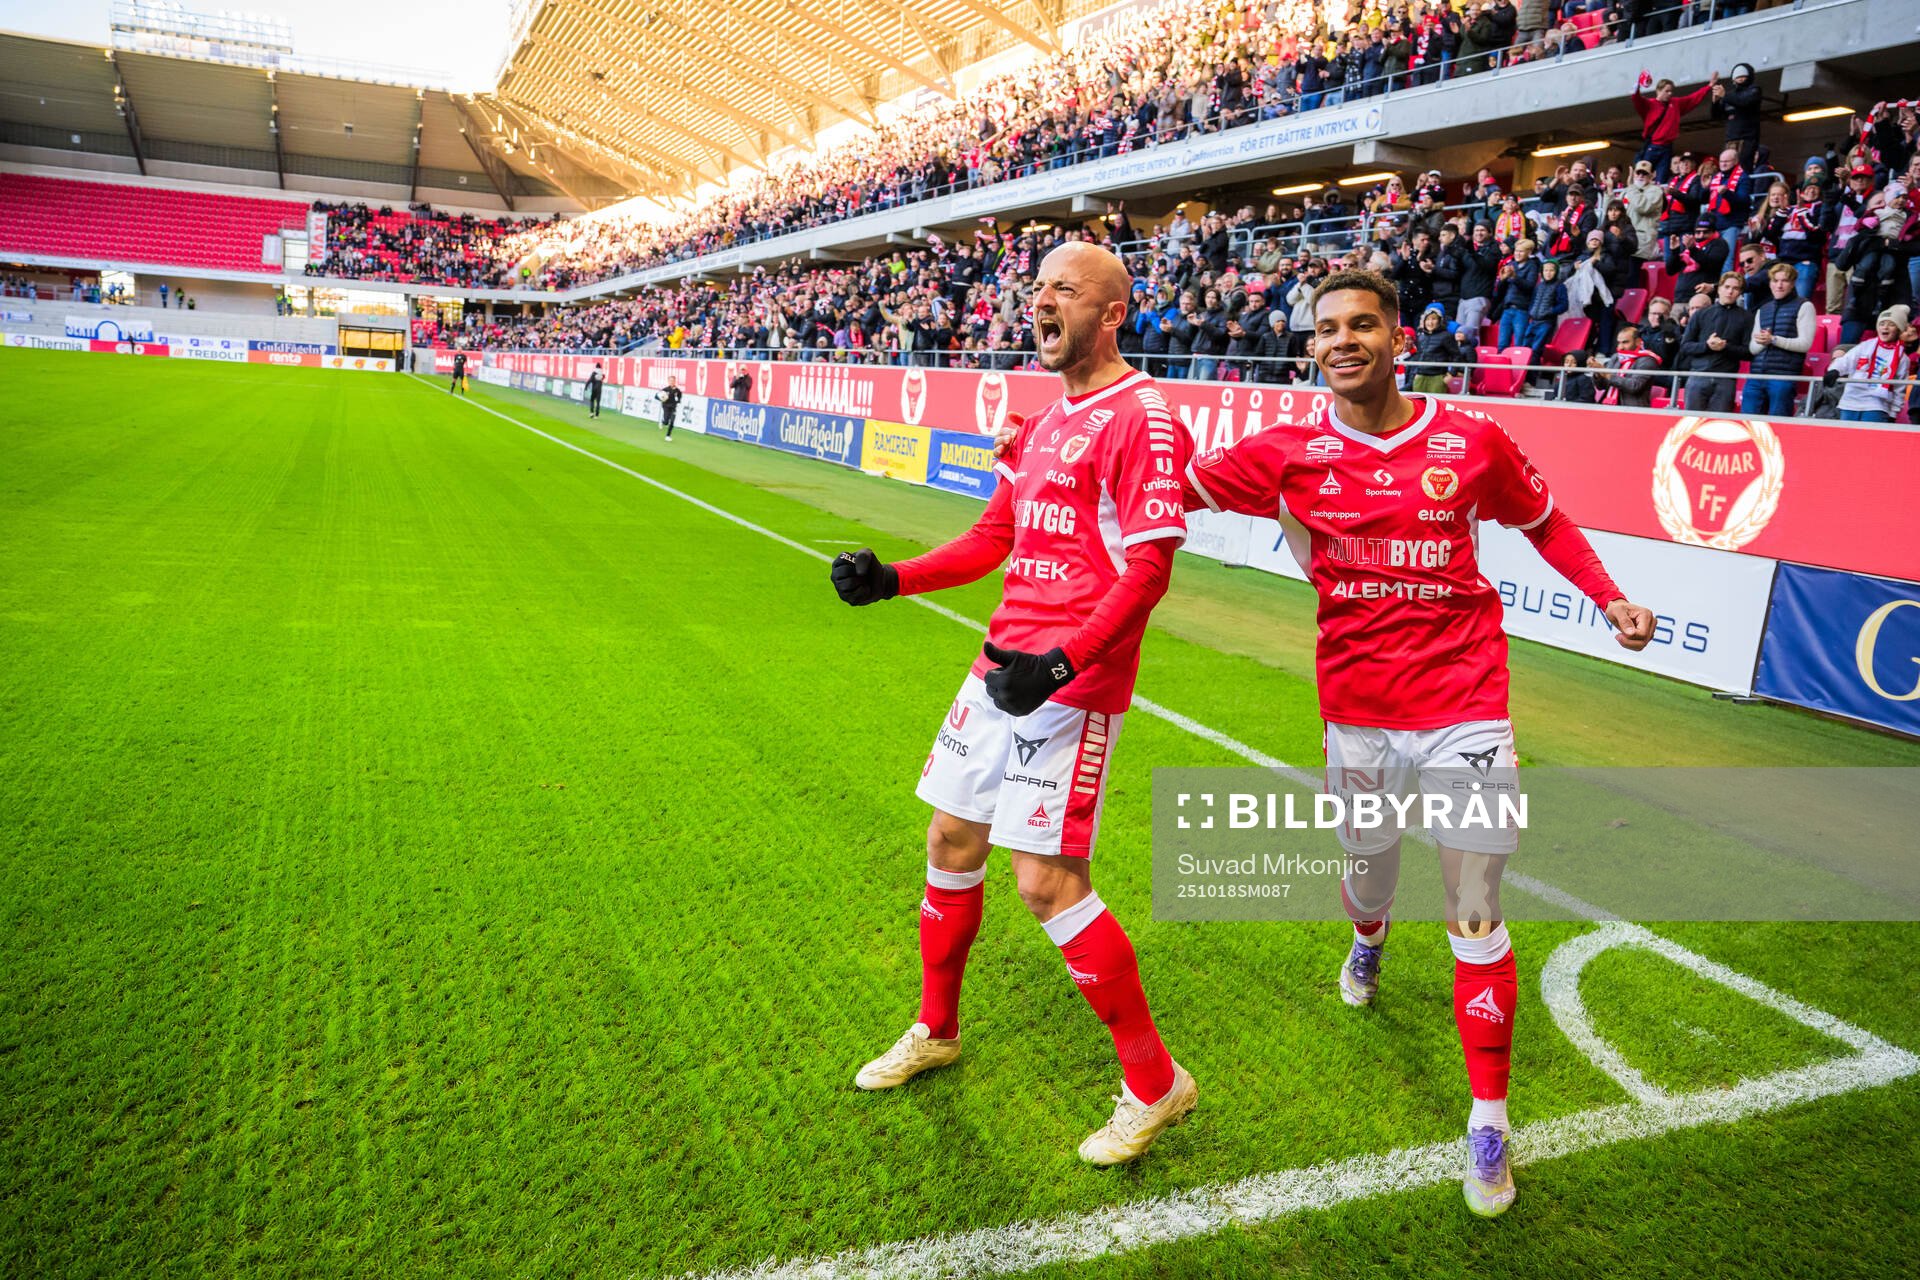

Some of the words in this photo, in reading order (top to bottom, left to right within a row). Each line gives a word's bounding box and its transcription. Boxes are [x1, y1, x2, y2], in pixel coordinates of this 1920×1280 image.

[1258, 134, 1275, 149] ETT
[1276, 126, 1312, 145] BÄTTRE
[1313, 116, 1358, 137] INTRYCK
[29, 336, 83, 352] Thermia
[188, 349, 245, 361] TREBOLIT
[269, 352, 302, 363] renta
[711, 402, 759, 441] GuldFågeln
[780, 412, 844, 458] GuldFågeln
[1681, 445, 1755, 475] KALMAR
[1365, 488, 1402, 497] Sportway
[1698, 483, 1727, 522] FF
[1327, 535, 1452, 568] MULTIBYGG
[1330, 580, 1453, 600] ALEMTEK
[1498, 581, 1710, 653] BUSINSS
[1051, 663, 1068, 681] 23
[1003, 771, 1058, 791] UPRA
[1027, 818, 1051, 828] SELECT
[1465, 1009, 1504, 1024] SELECT
